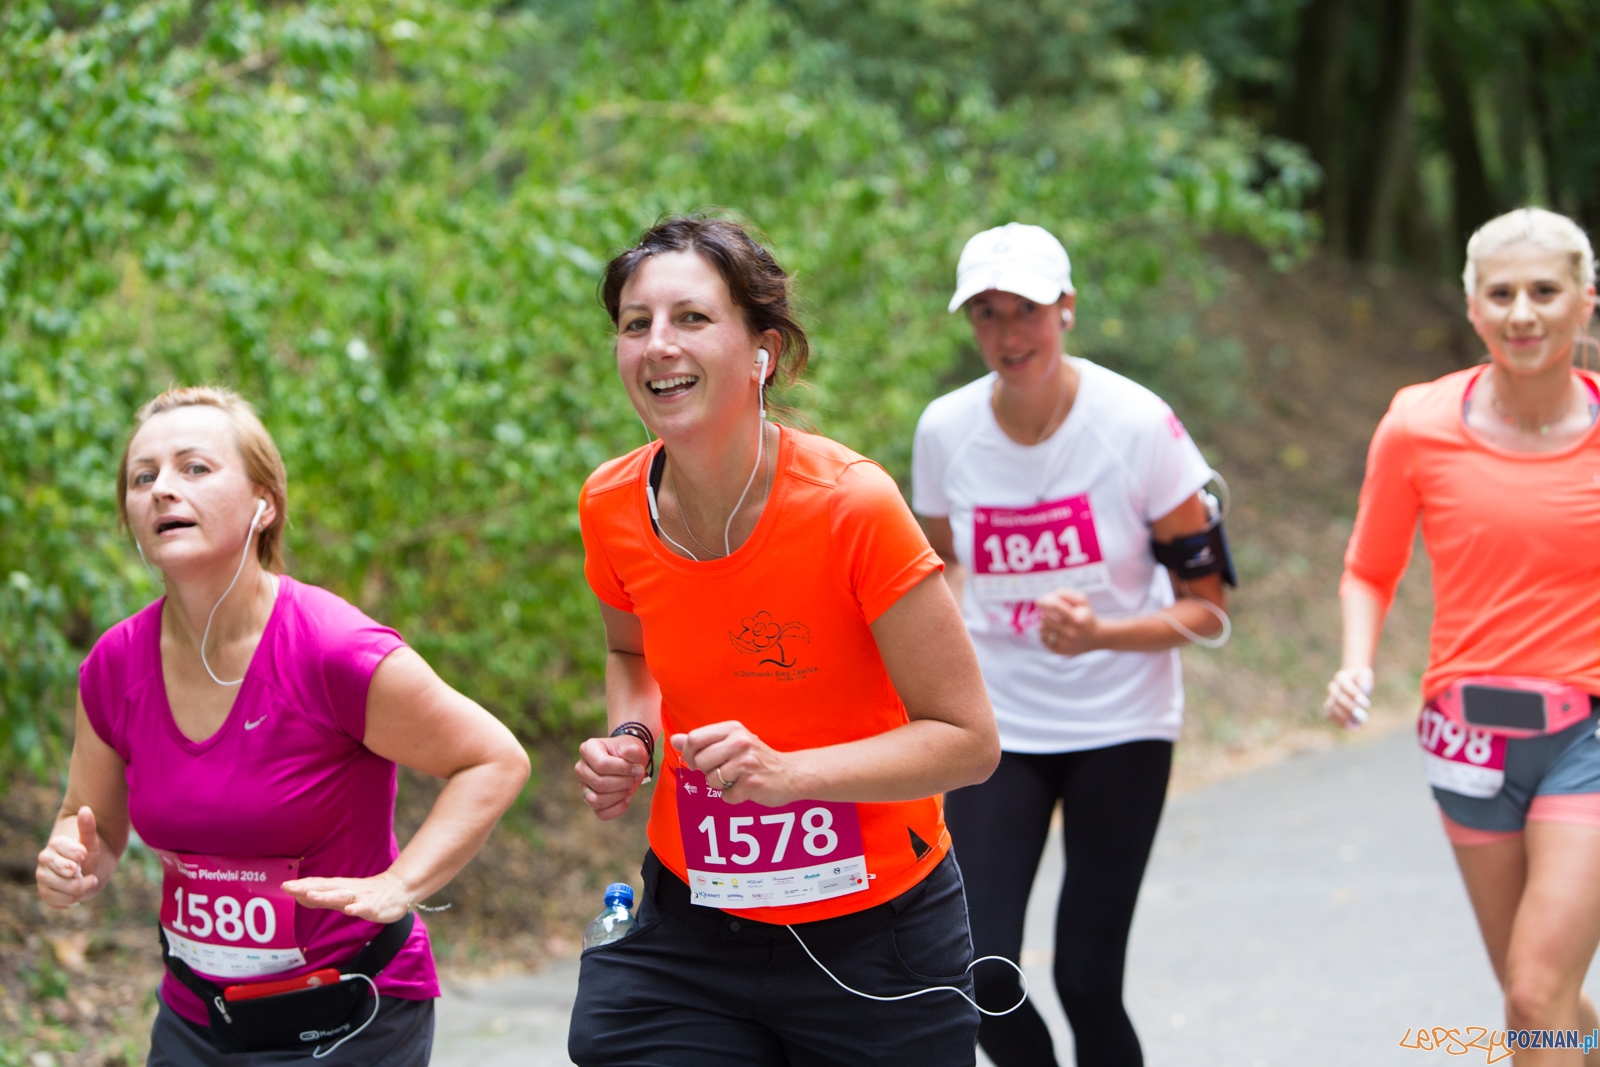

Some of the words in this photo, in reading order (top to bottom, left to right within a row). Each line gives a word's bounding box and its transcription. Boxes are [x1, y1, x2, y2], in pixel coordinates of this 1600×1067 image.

[983, 525, 1090, 573] 1841
[1421, 708, 1493, 766] 1798
[706, 787, 722, 798] Zaw
[697, 807, 839, 866] 1578
[198, 868, 239, 882] Pier(w)si
[240, 871, 267, 883] 2016
[172, 886, 276, 944] 1580
